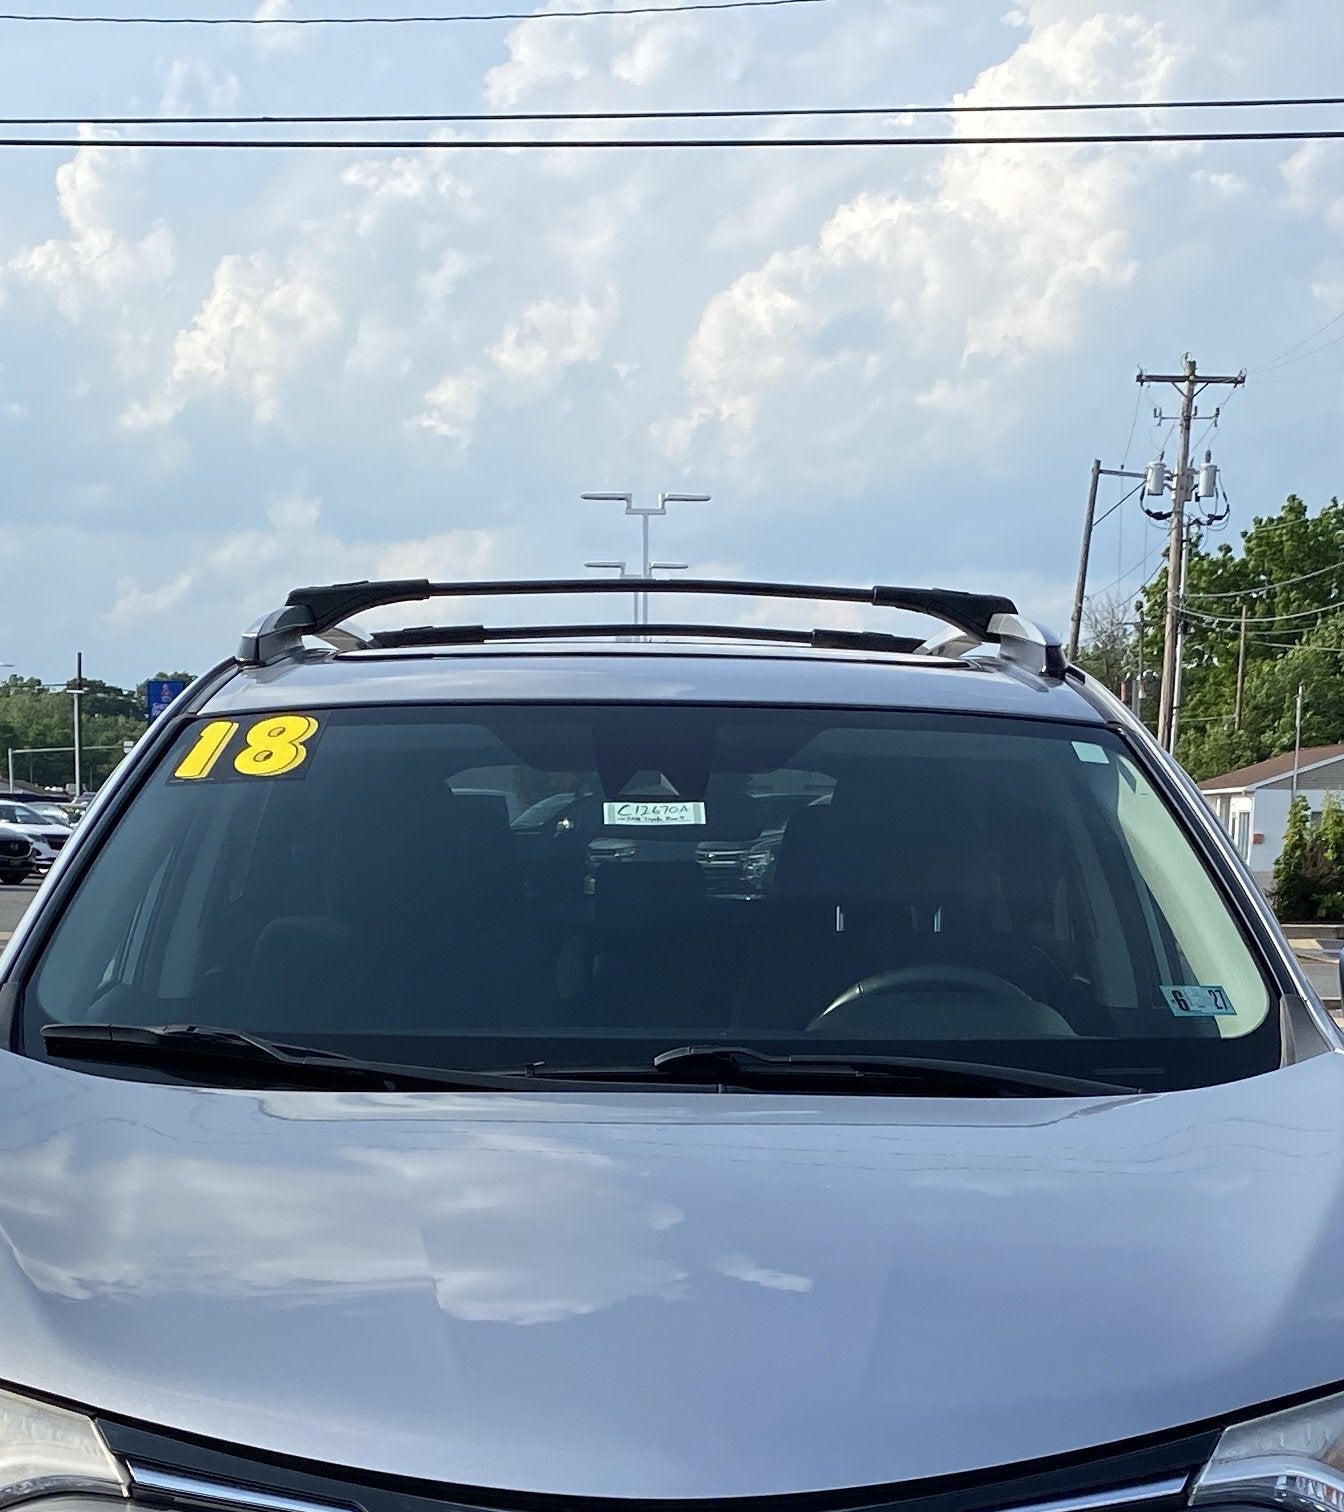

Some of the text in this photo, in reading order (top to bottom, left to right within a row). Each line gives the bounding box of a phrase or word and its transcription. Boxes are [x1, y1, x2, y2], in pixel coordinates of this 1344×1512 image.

[174, 714, 319, 779] 18
[617, 804, 688, 816] C12670A
[1171, 989, 1228, 1012] 6 27
